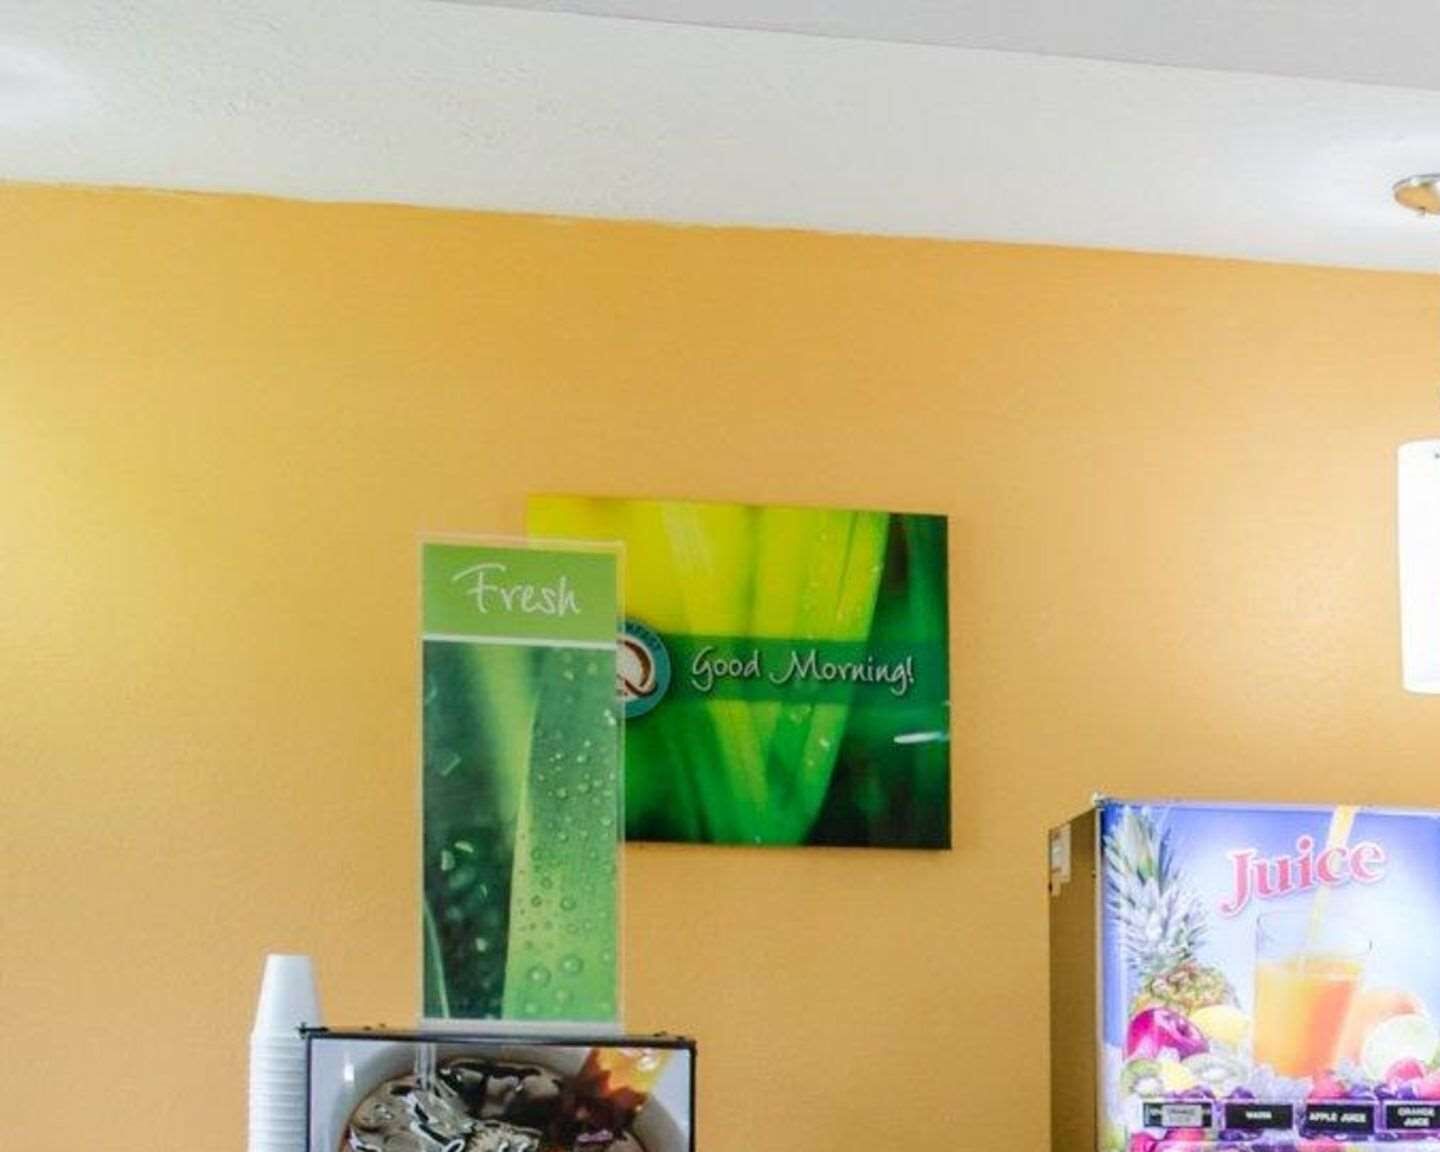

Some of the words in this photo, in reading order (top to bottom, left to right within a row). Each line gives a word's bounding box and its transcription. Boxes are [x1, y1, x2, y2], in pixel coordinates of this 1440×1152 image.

[452, 563, 582, 617] Fresh
[691, 645, 760, 692] Good
[769, 649, 914, 697] Morning!
[1218, 835, 1386, 917] Juice
[1308, 1112, 1338, 1123] APPLE
[1340, 1112, 1367, 1123] JUICE
